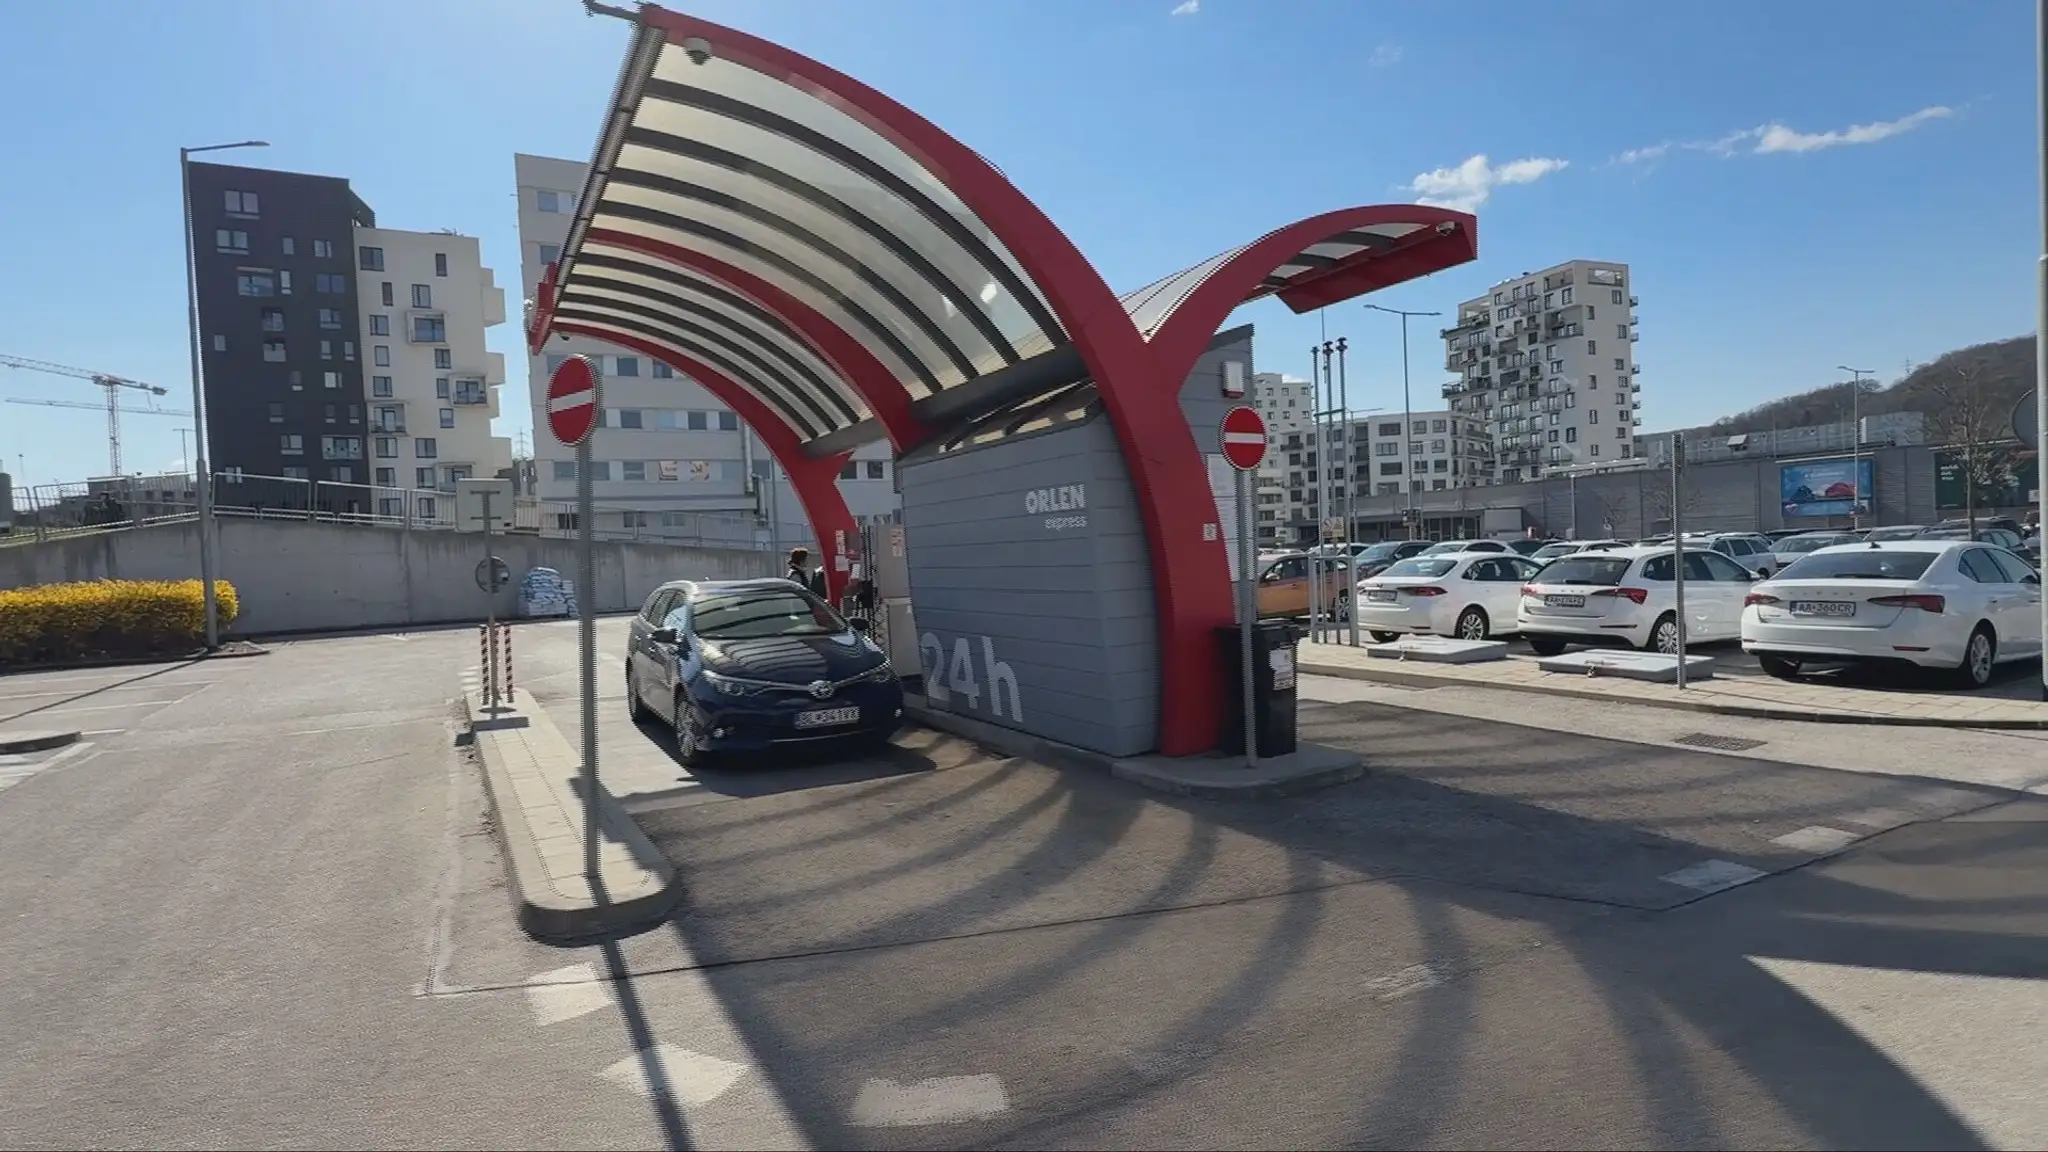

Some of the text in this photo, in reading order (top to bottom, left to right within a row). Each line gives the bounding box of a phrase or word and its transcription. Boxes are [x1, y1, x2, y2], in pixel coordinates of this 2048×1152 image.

[1025, 483, 1086, 514] ORLEN
[1044, 514, 1087, 531] express
[920, 631, 1023, 723] 24h
